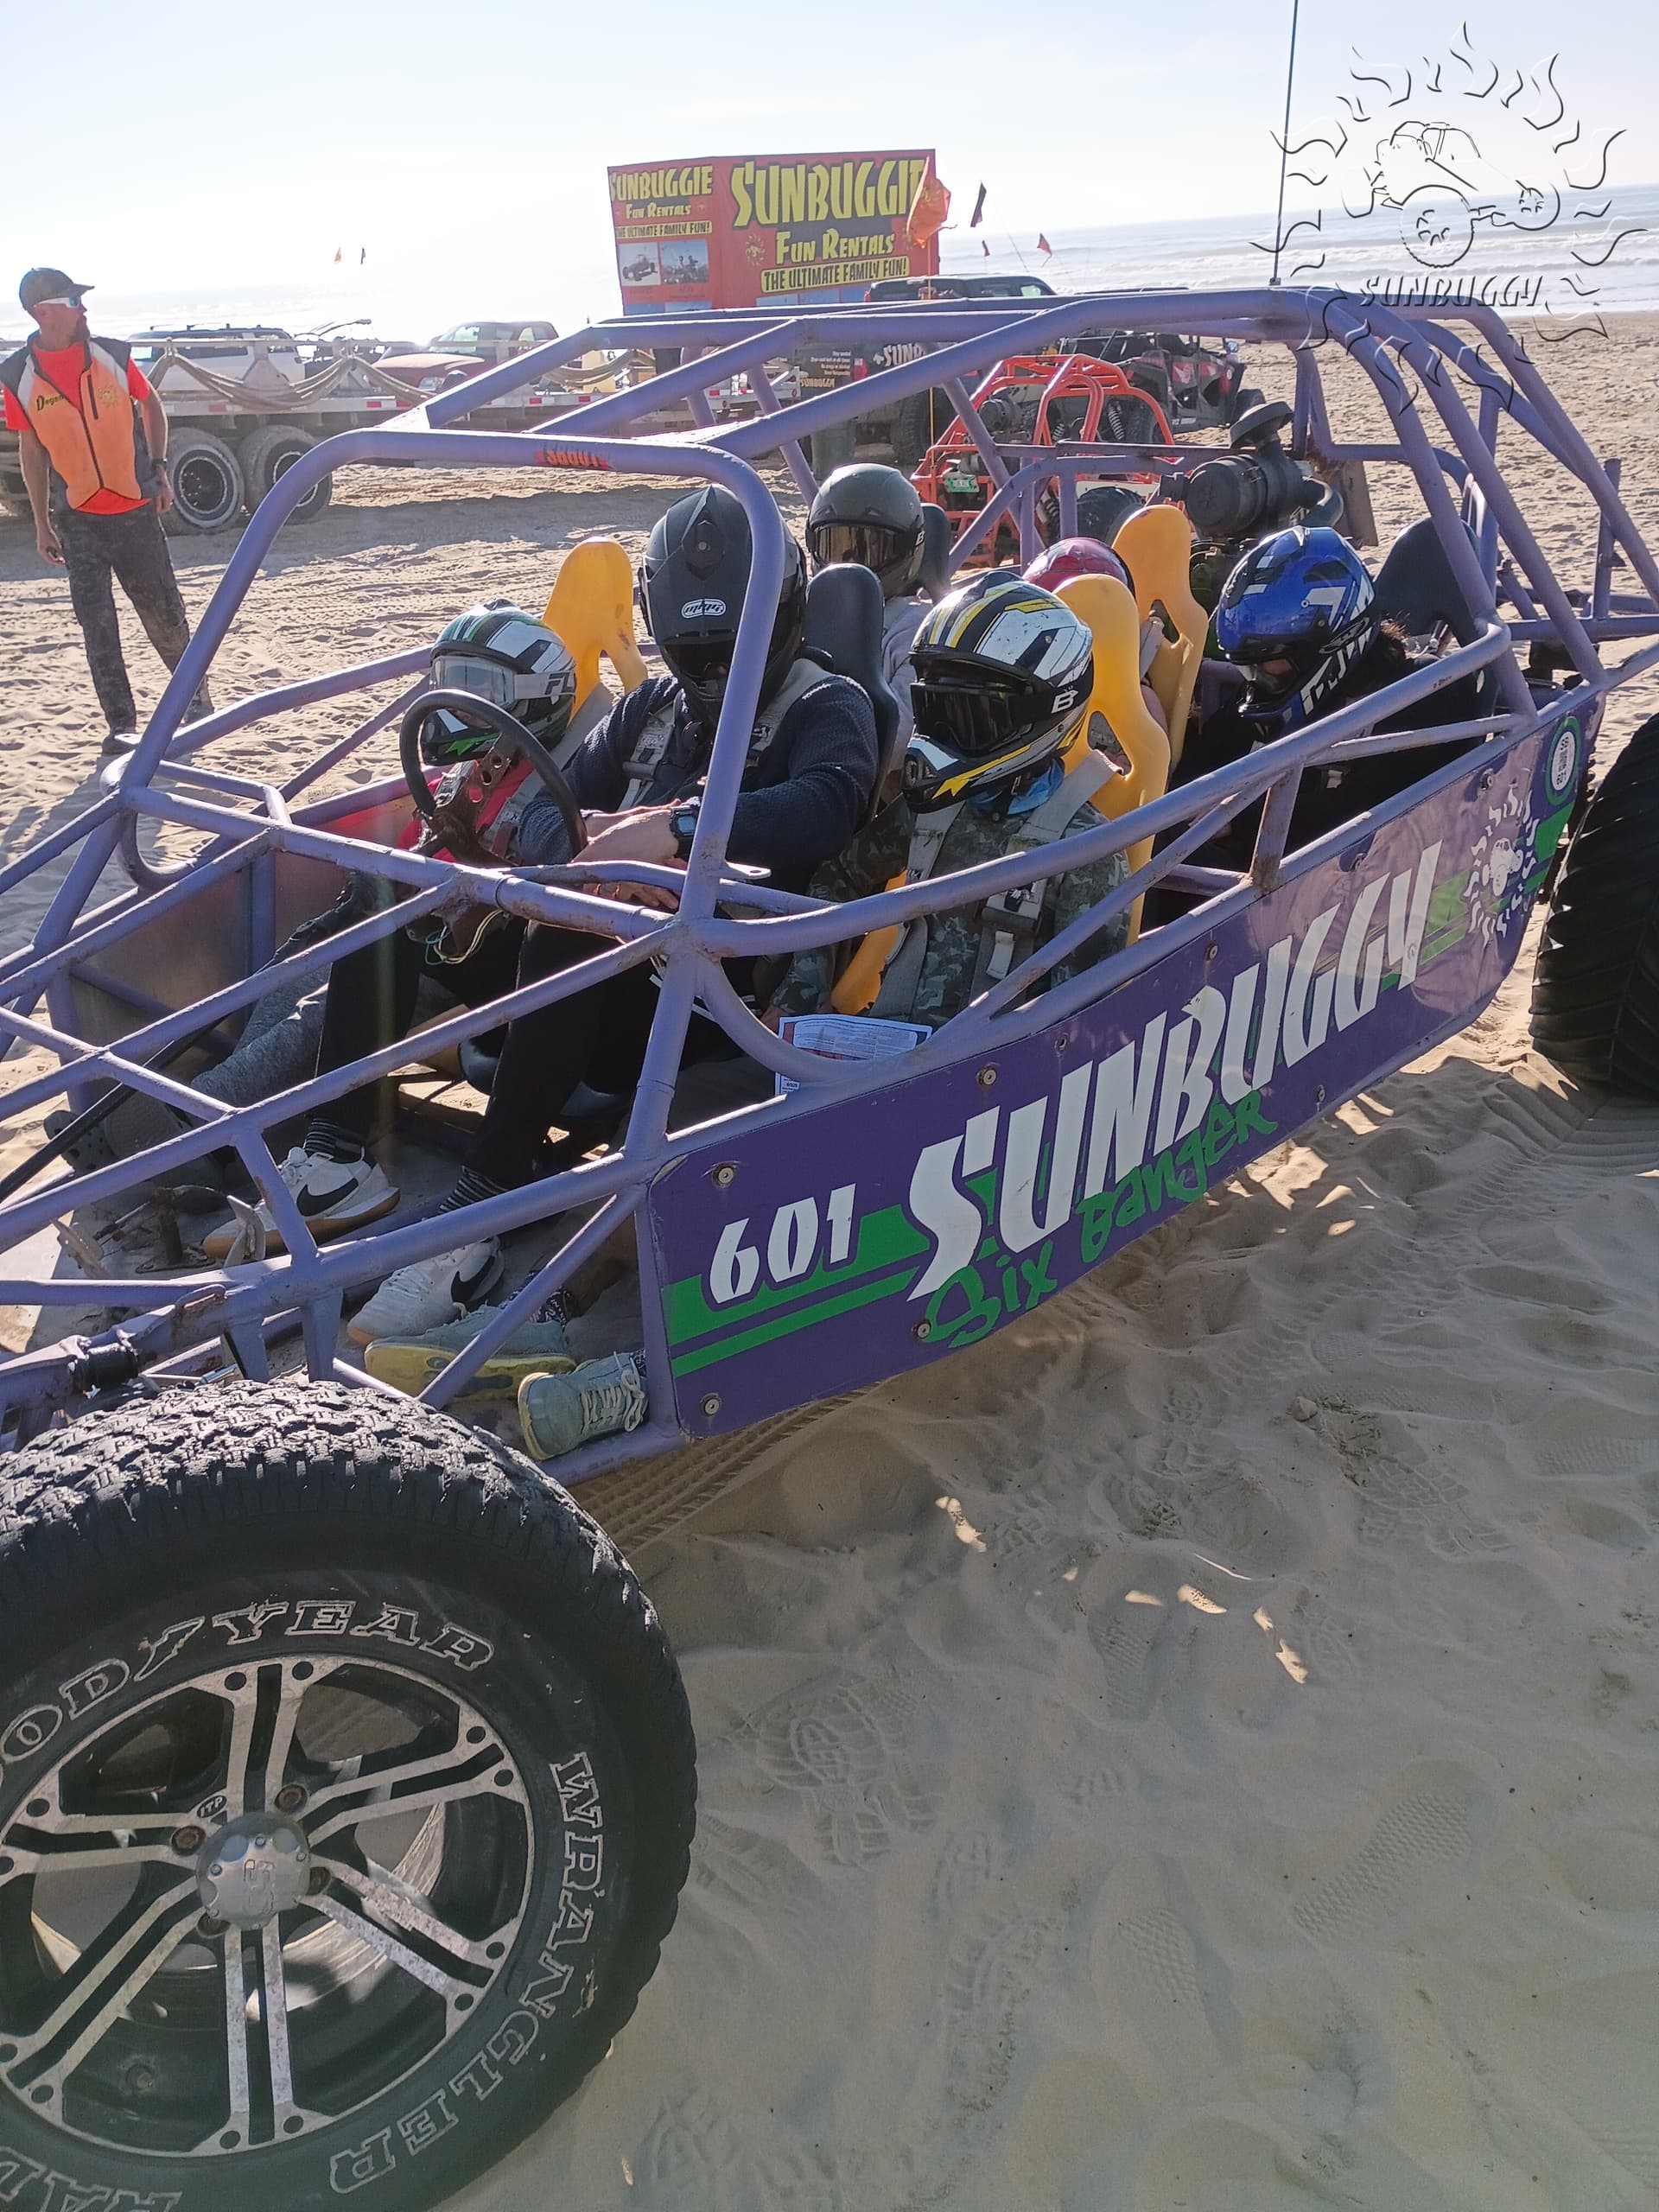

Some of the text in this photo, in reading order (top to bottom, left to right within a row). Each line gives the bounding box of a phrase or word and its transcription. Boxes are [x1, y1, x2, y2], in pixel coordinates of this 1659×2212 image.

[609, 166, 713, 201] SUNBUGGIE
[764, 257, 907, 291] THE ULTIMATE FAMILY FUN!
[776, 228, 895, 264] FUN RENTALS
[907, 839, 1443, 1302] SUNBUGGY
[709, 1183, 856, 1304] 601
[921, 1239, 1058, 1348] Six
[199, 1796, 223, 1817] ITP
[330, 1752, 605, 2194] WRANGLER
